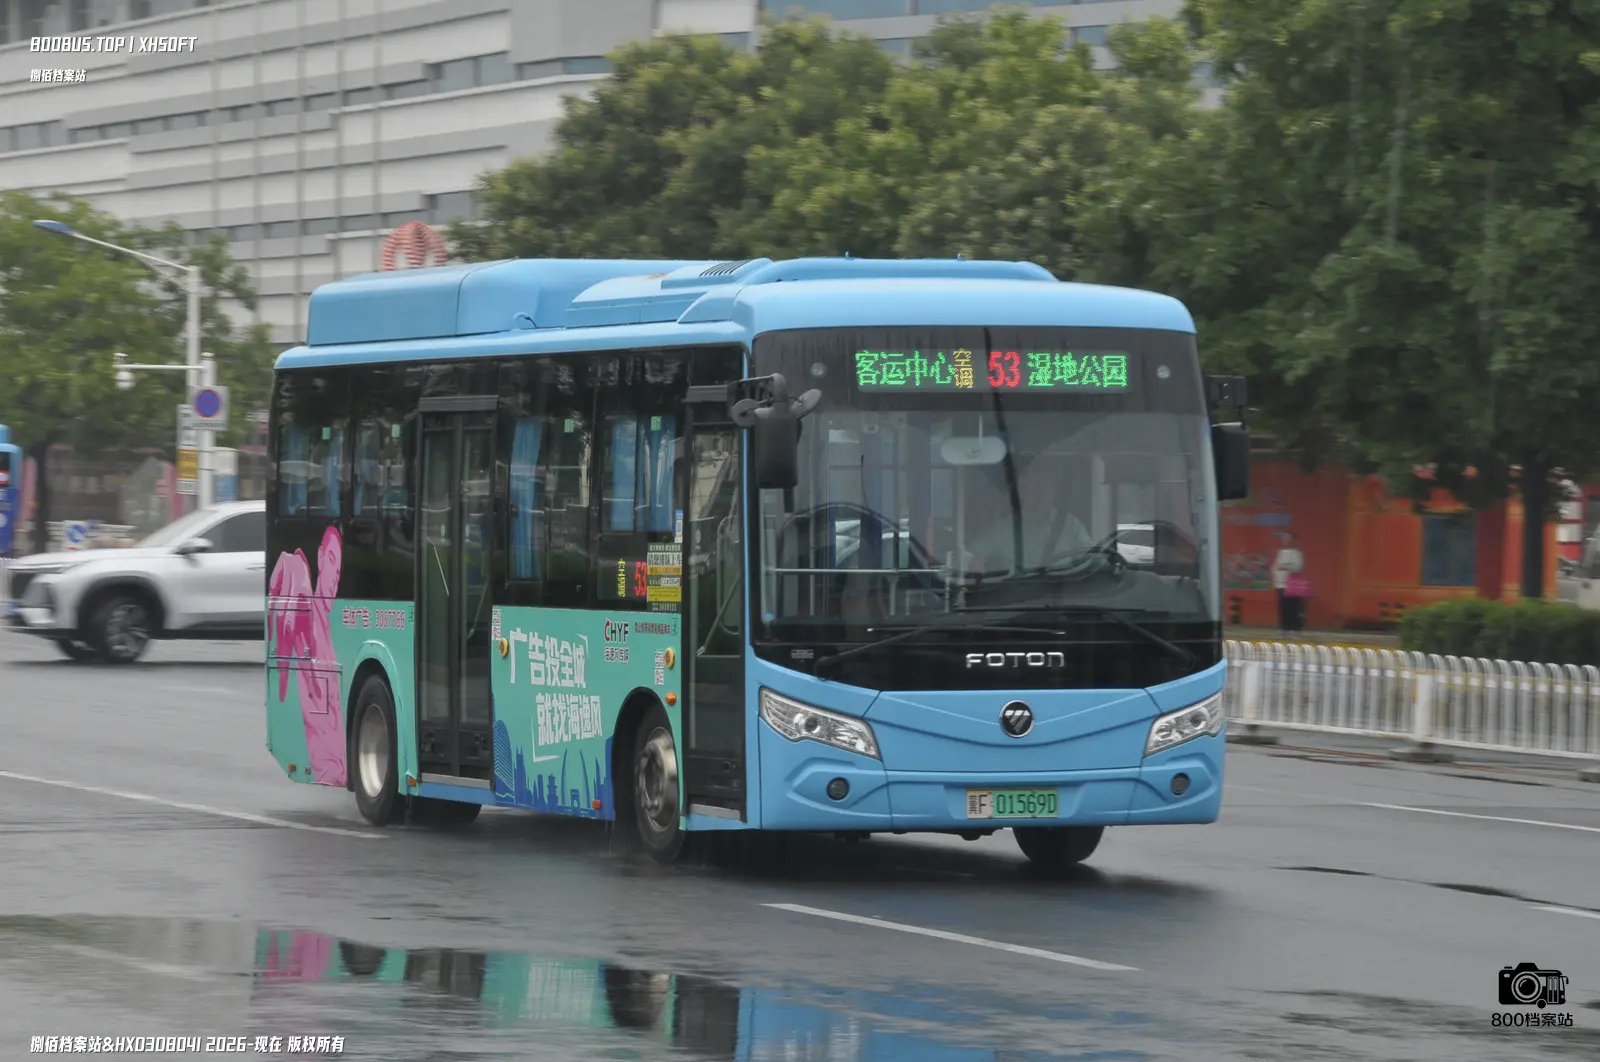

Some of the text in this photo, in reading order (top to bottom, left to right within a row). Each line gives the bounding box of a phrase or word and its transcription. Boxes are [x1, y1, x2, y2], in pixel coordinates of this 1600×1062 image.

[855, 347, 1129, 389] 客运中心 空调 53 湿地公园
[635, 561, 647, 597] 53
[604, 619, 630, 643] CHYF
[509, 627, 587, 689] 广告投全城
[966, 652, 1065, 668] FOTON
[535, 692, 604, 747] 就找海逸风
